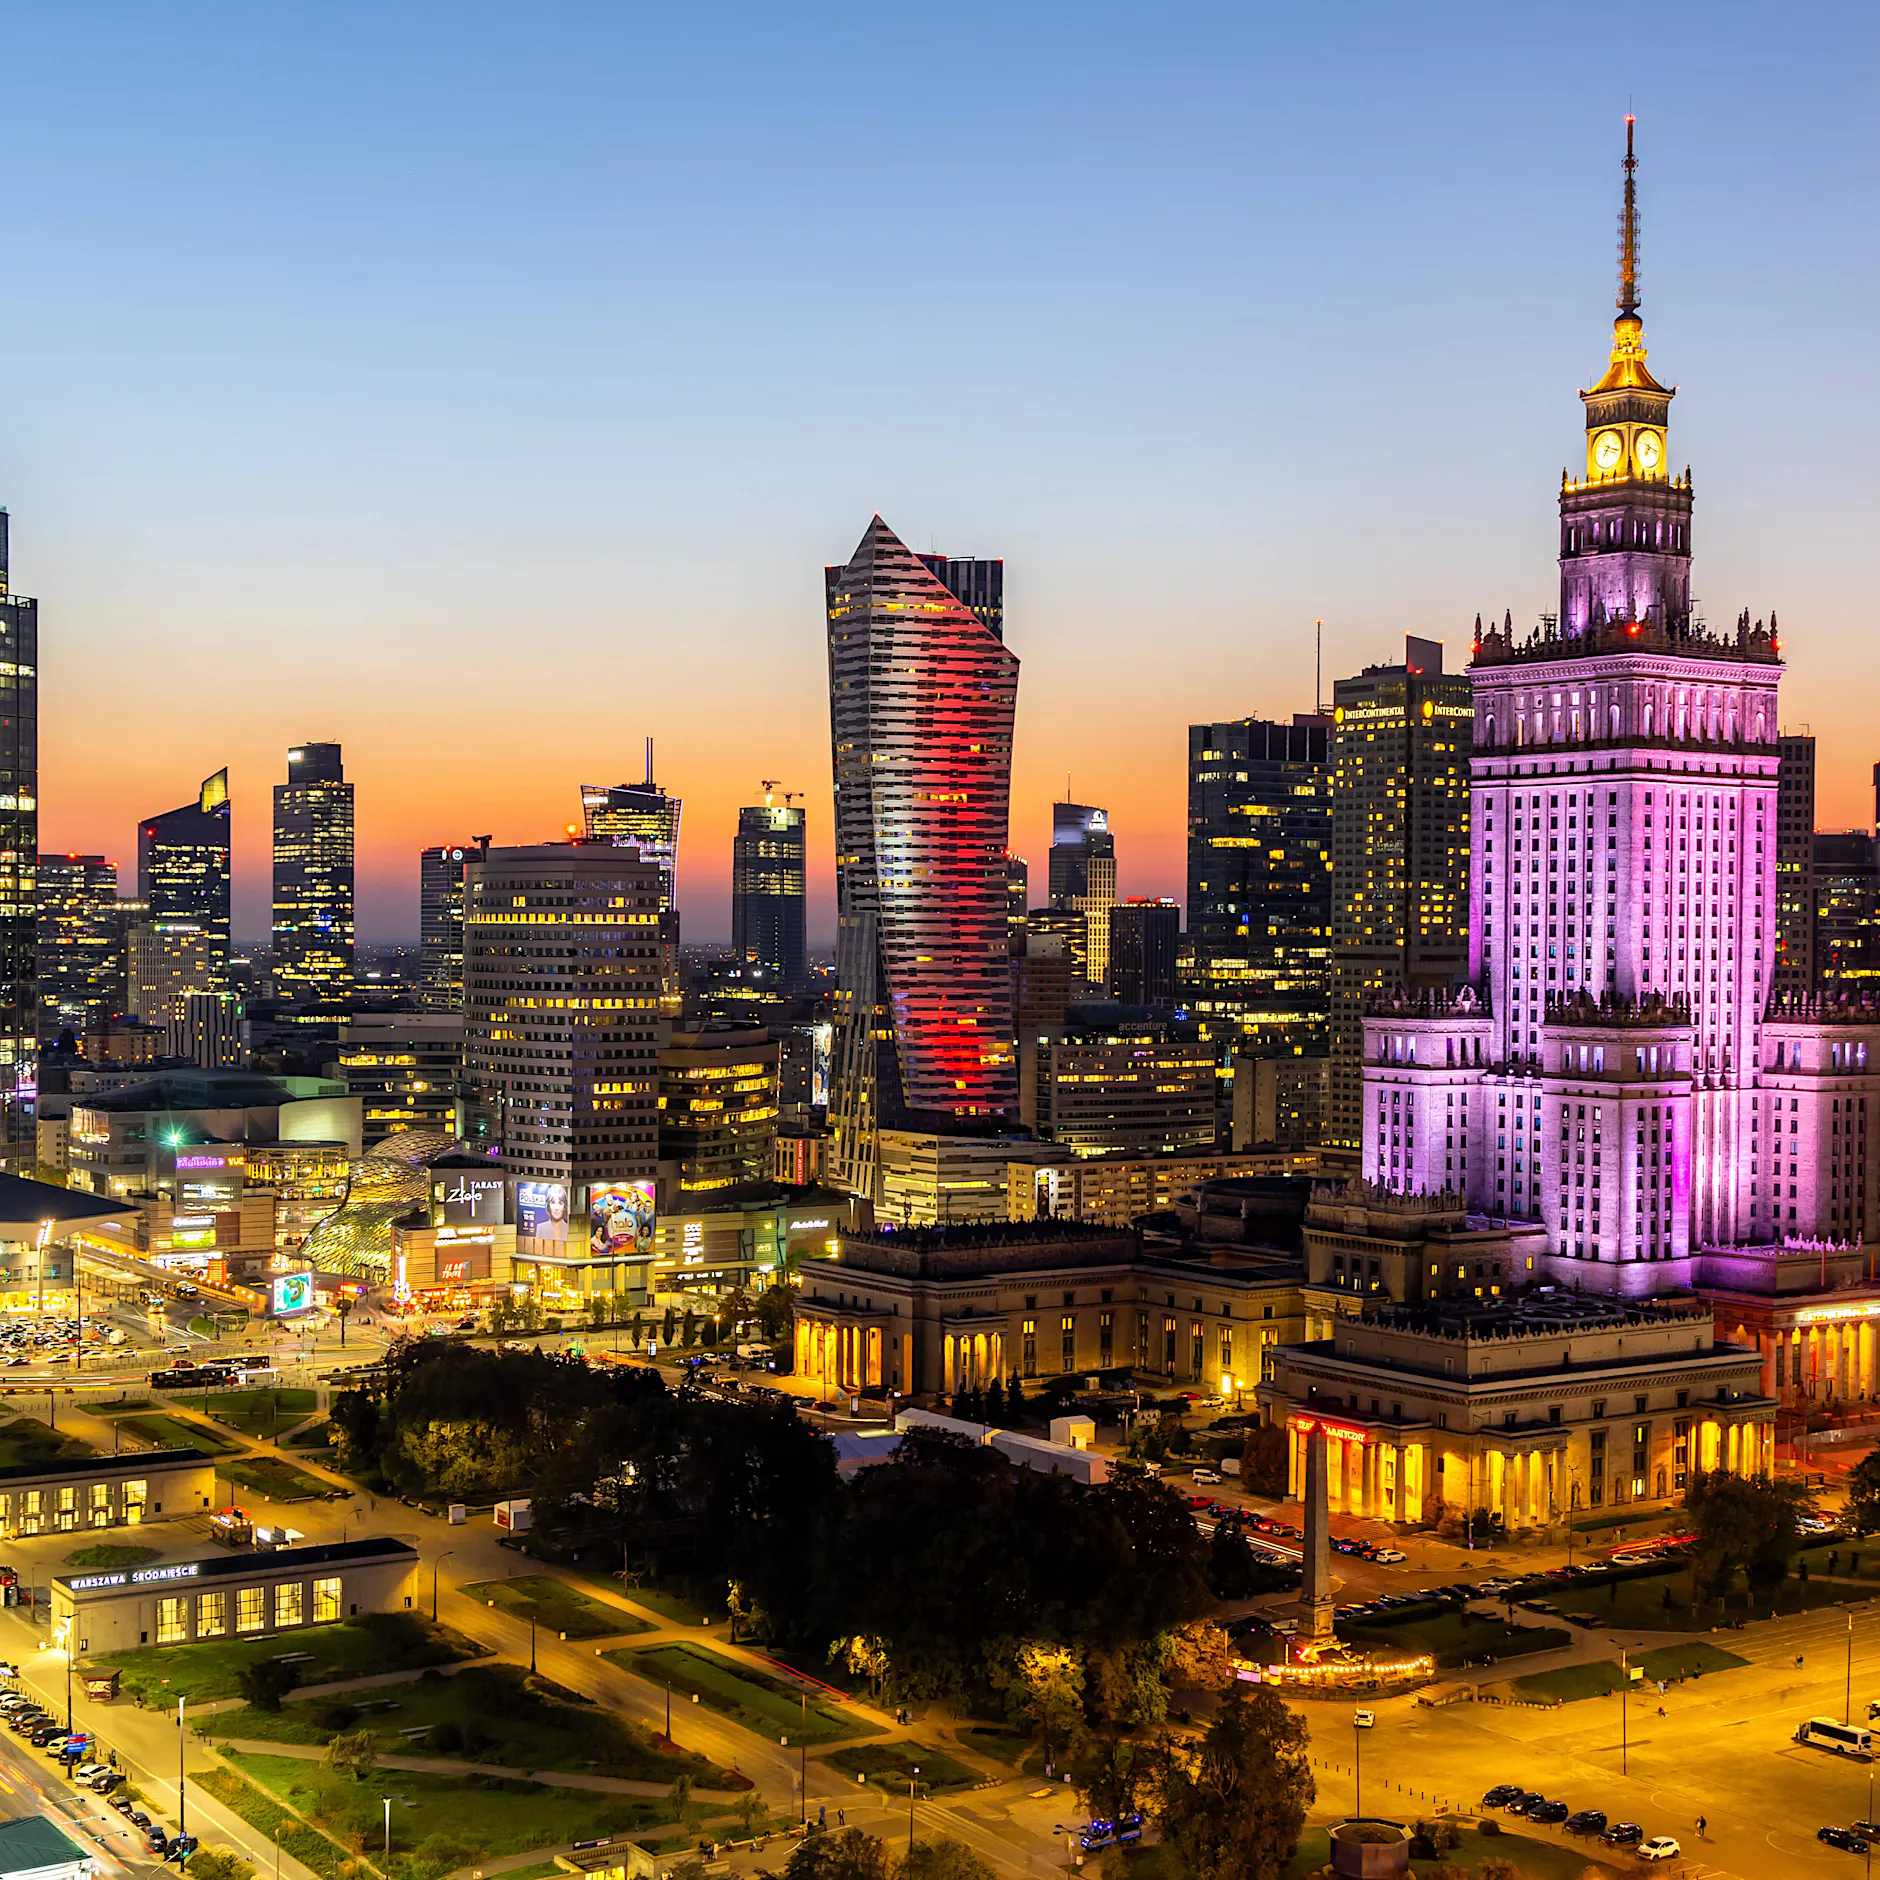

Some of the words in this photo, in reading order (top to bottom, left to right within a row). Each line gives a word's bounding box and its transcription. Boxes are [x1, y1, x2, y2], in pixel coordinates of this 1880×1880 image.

[1118, 1021, 1168, 1031] accenture
[176, 1157, 225, 1168] Multikino
[470, 1181, 503, 1190] TARASY
[520, 1194, 545, 1203] POLSKA
[70, 1574, 126, 1590] WARSZAWA
[132, 1562, 199, 1582] ŚRÓDMIEŚCIE
